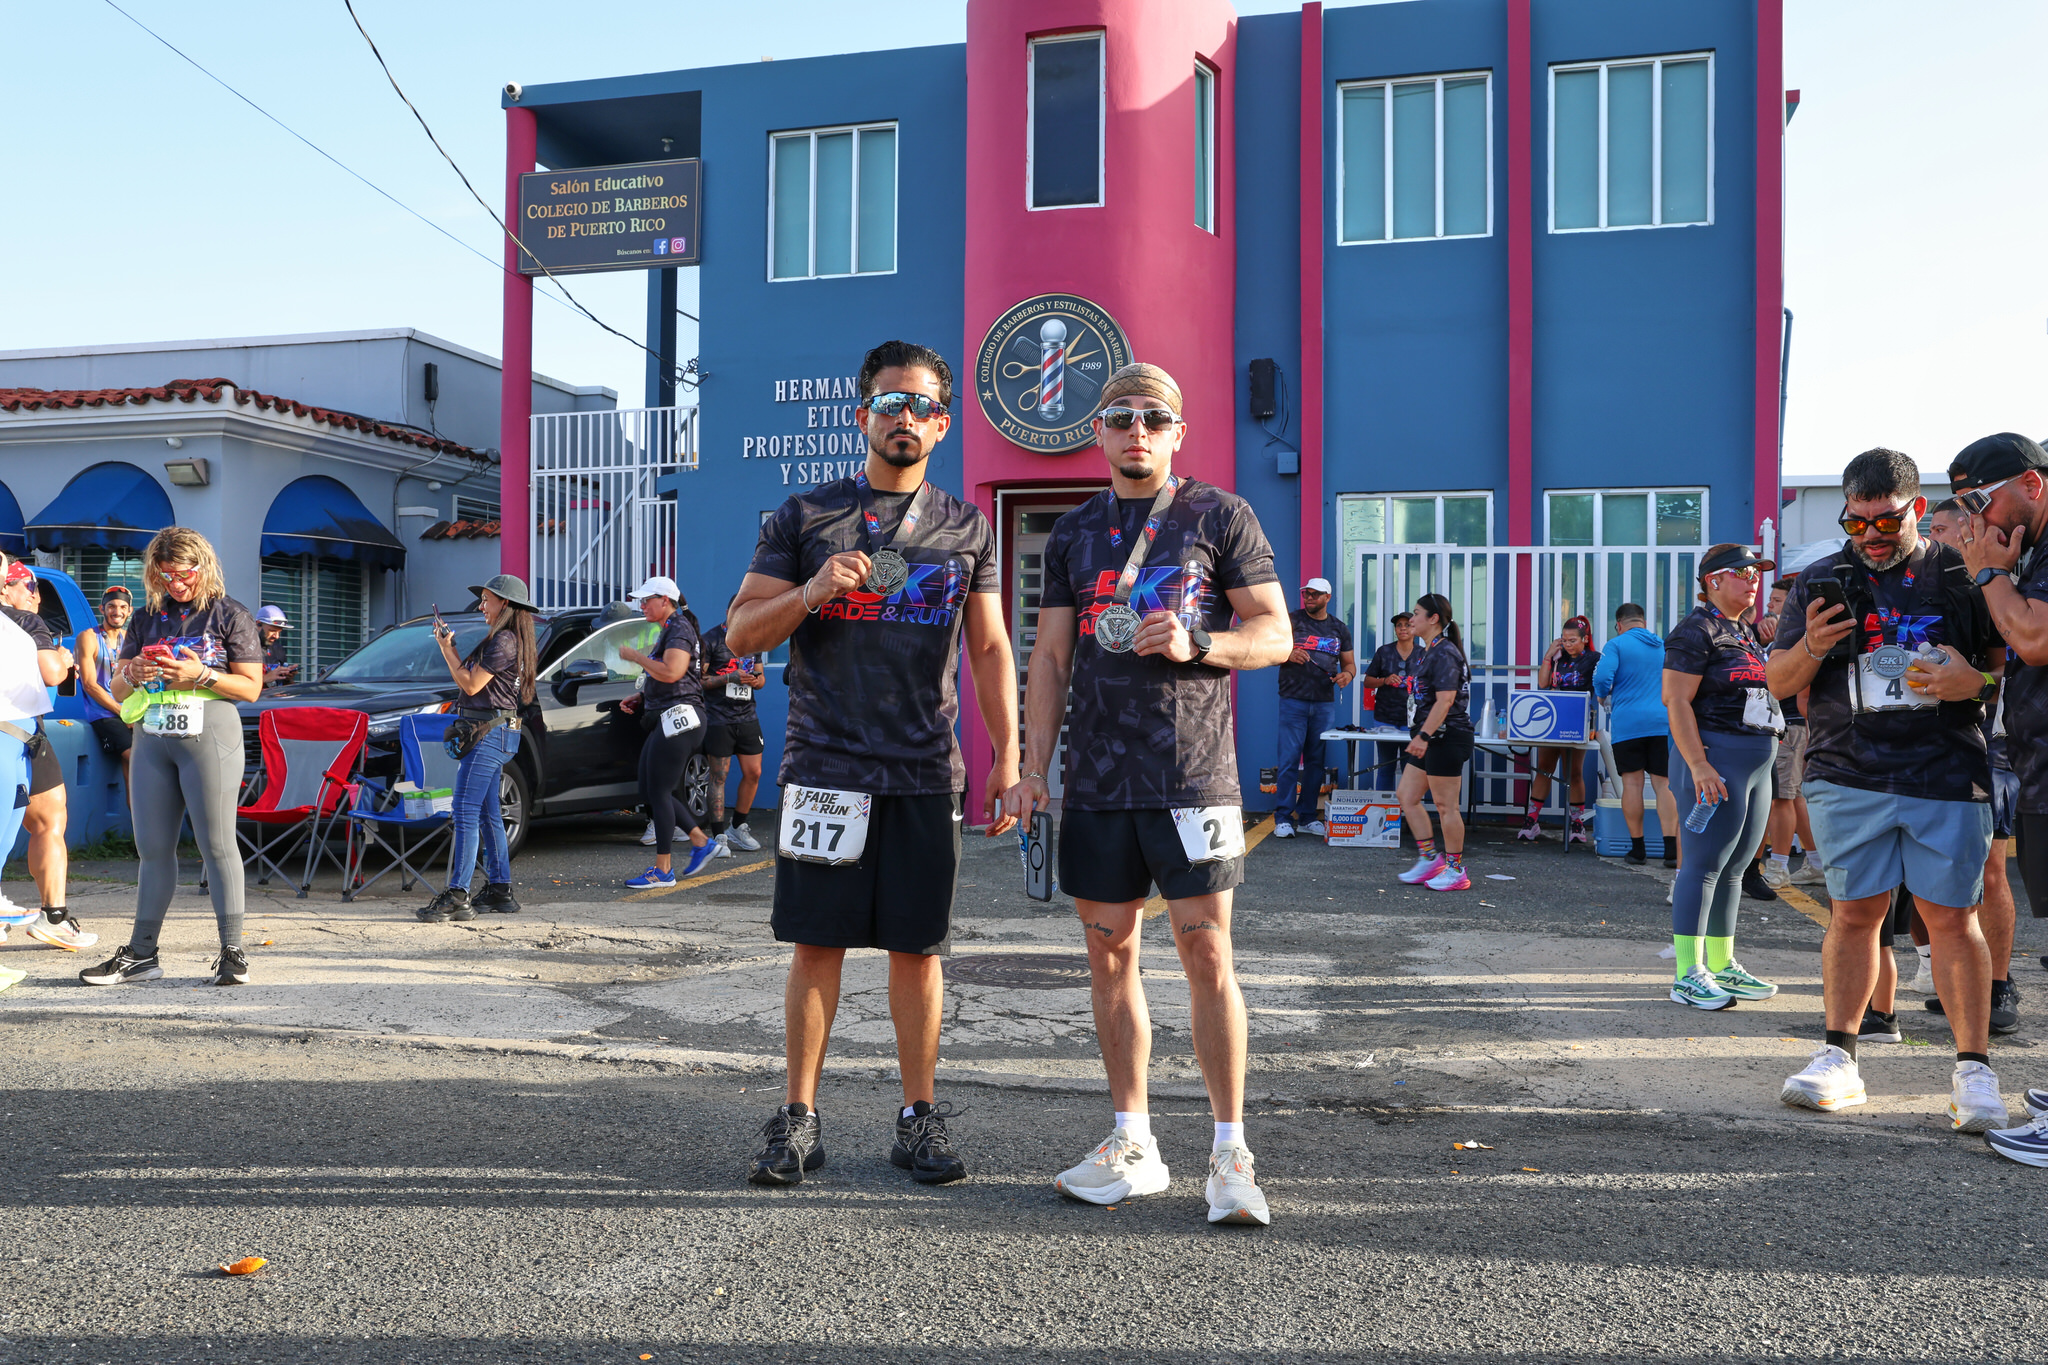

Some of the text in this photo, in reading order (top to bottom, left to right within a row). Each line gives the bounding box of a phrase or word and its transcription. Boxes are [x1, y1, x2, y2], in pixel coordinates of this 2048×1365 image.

[550, 175, 664, 196] Salón Educativo
[526, 195, 688, 219] COLEGIO DE BARBEROS
[547, 217, 666, 239] DE PUERTO RICO
[980, 341, 997, 383] COLEGIO
[994, 329, 1006, 343] DE
[1002, 302, 1046, 331] BARBEROS
[1046, 301, 1053, 310] Y
[1053, 300, 1100, 323] ESTILISTAS
[1097, 319, 1110, 333] EN
[1080, 361, 1102, 371] 1989
[774, 376, 862, 402] HERMAN
[999, 417, 1061, 446] PUERTO
[780, 463, 792, 485] Y
[820, 603, 882, 622] FADE
[881, 605, 898, 623] &
[1112, 606, 1126, 614] 5K
[1729, 671, 1766, 682] FADE
[733, 686, 749, 697] 129
[1885, 677, 1904, 700] 4
[158, 714, 189, 731] 88
[673, 715, 689, 730] 60
[804, 790, 840, 805] FADE
[811, 803, 819, 812] &
[819, 804, 851, 816] RUN
[1333, 815, 1350, 823] 6,000
[791, 818, 846, 852] 217
[1203, 818, 1228, 851] 2
